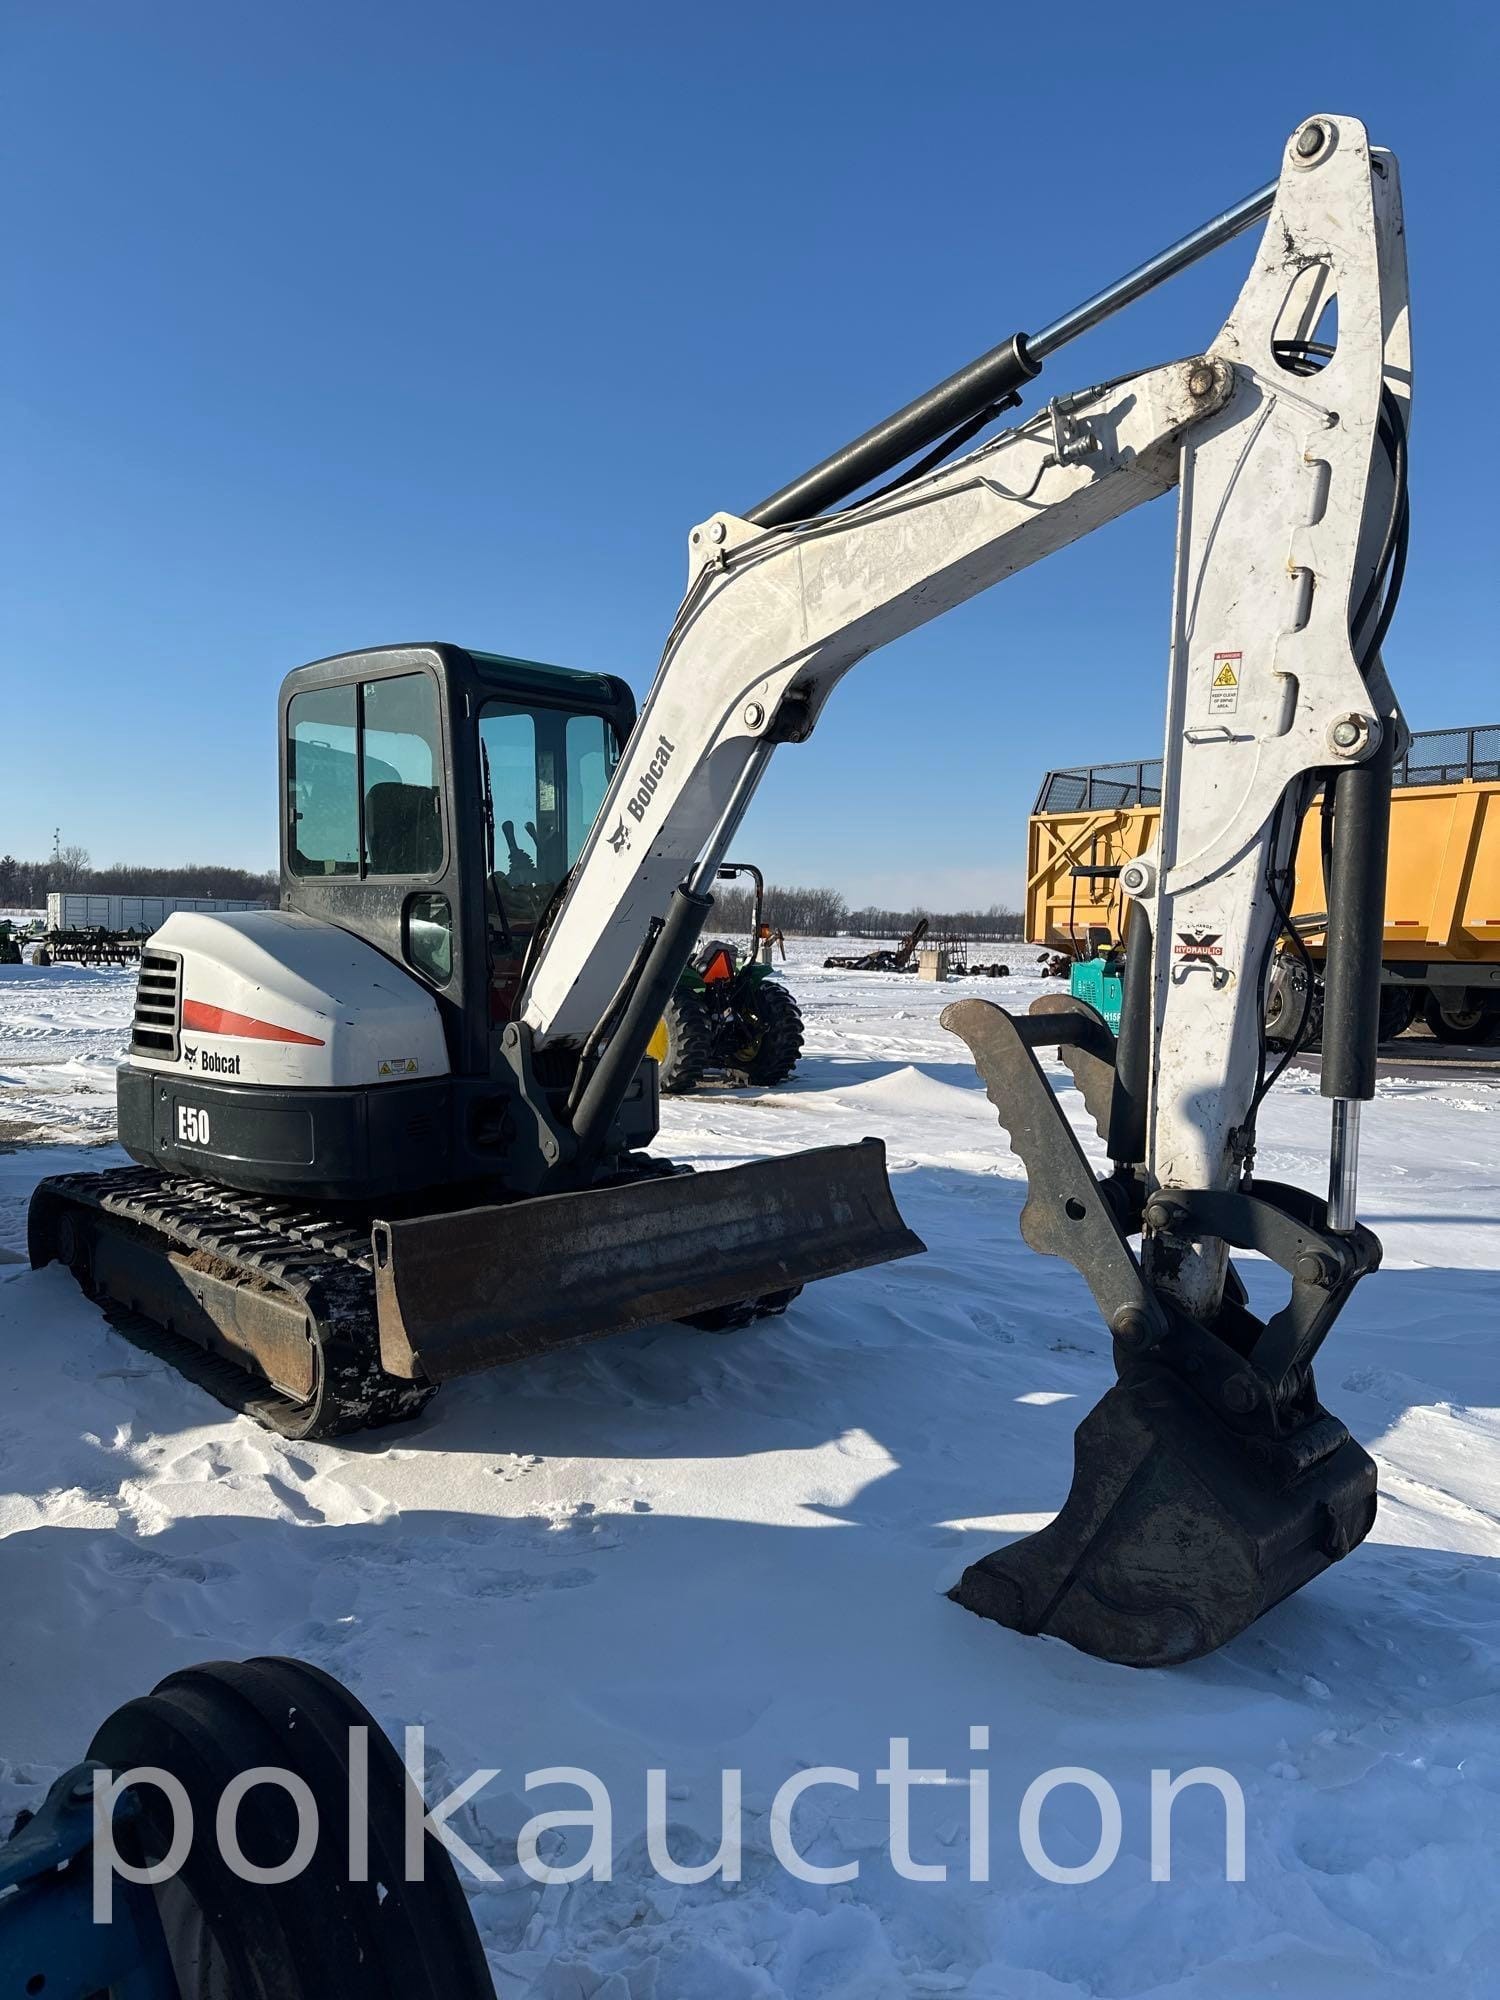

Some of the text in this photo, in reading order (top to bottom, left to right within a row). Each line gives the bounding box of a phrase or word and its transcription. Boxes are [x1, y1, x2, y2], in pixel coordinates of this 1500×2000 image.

[627, 734, 675, 823] Bobcat
[1175, 946, 1221, 955] HYDRAULIC
[201, 1050, 241, 1075] Bobcat
[178, 1105, 210, 1145] E50
